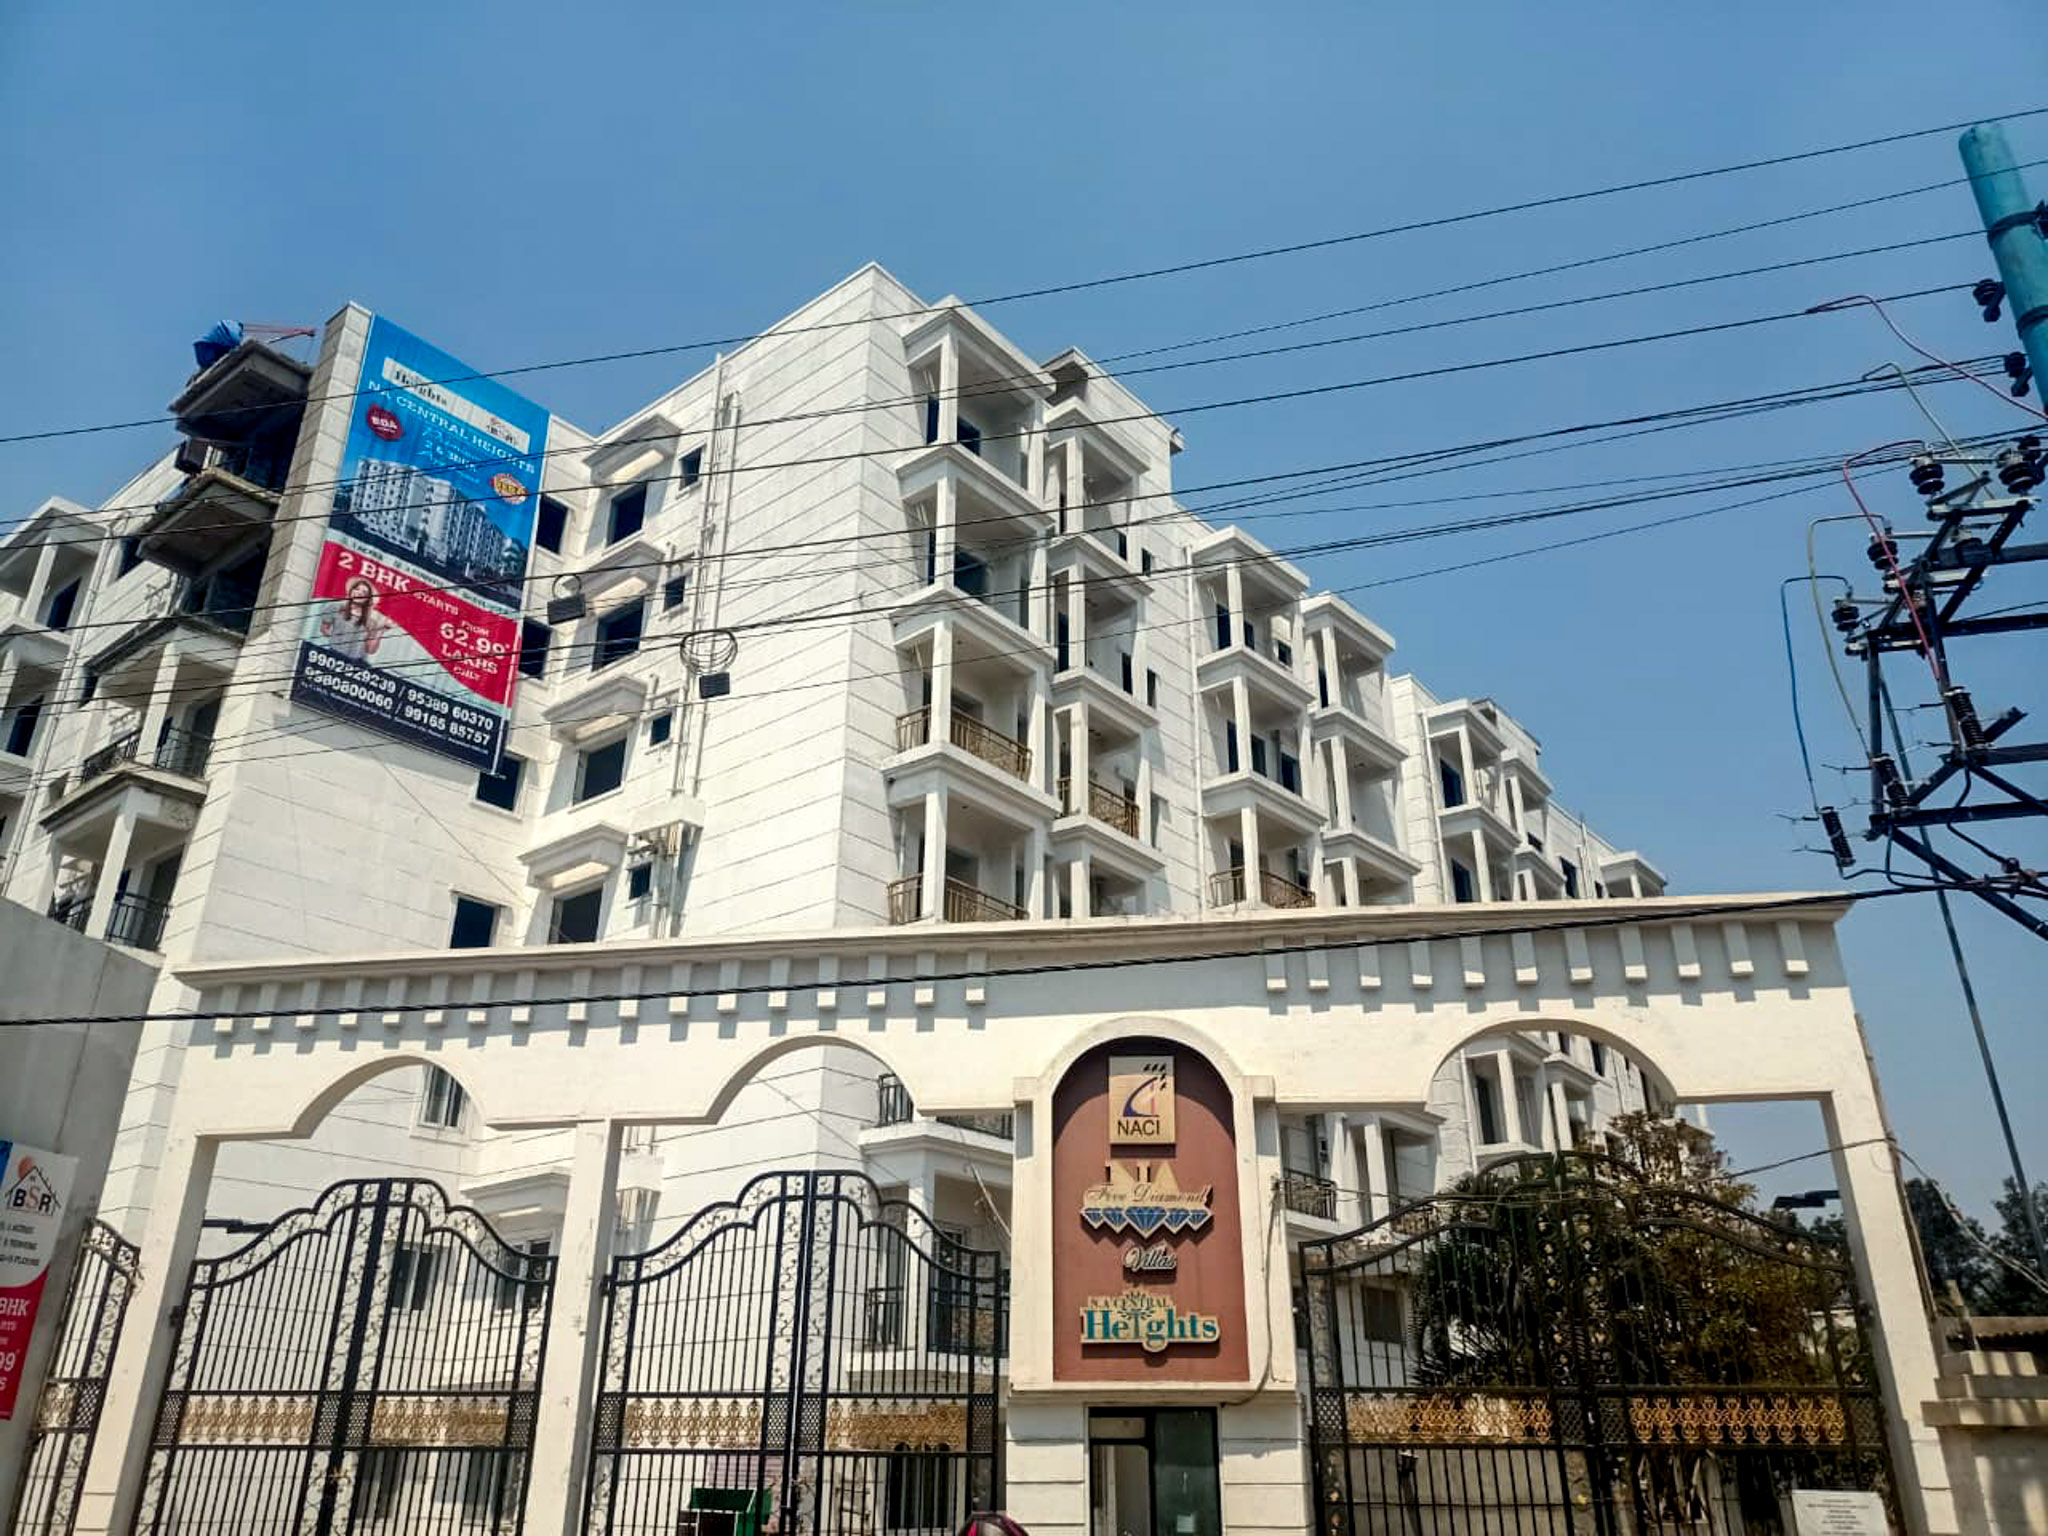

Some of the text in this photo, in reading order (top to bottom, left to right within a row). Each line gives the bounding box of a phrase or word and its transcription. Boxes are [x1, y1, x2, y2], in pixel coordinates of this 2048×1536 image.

[396, 396, 468, 440] CENTRAL
[338, 551, 411, 592] 2 BHK
[413, 591, 459, 616] STARTS
[441, 642, 499, 676] LAKHS
[451, 705, 494, 731] 60370
[1117, 1119, 1161, 1137] NACI
[13, 1187, 52, 1214] BSR
[1132, 1183, 1208, 1202] Diamond
[1123, 1246, 1177, 1271] Villas
[1085, 1307, 1218, 1350] Heights
